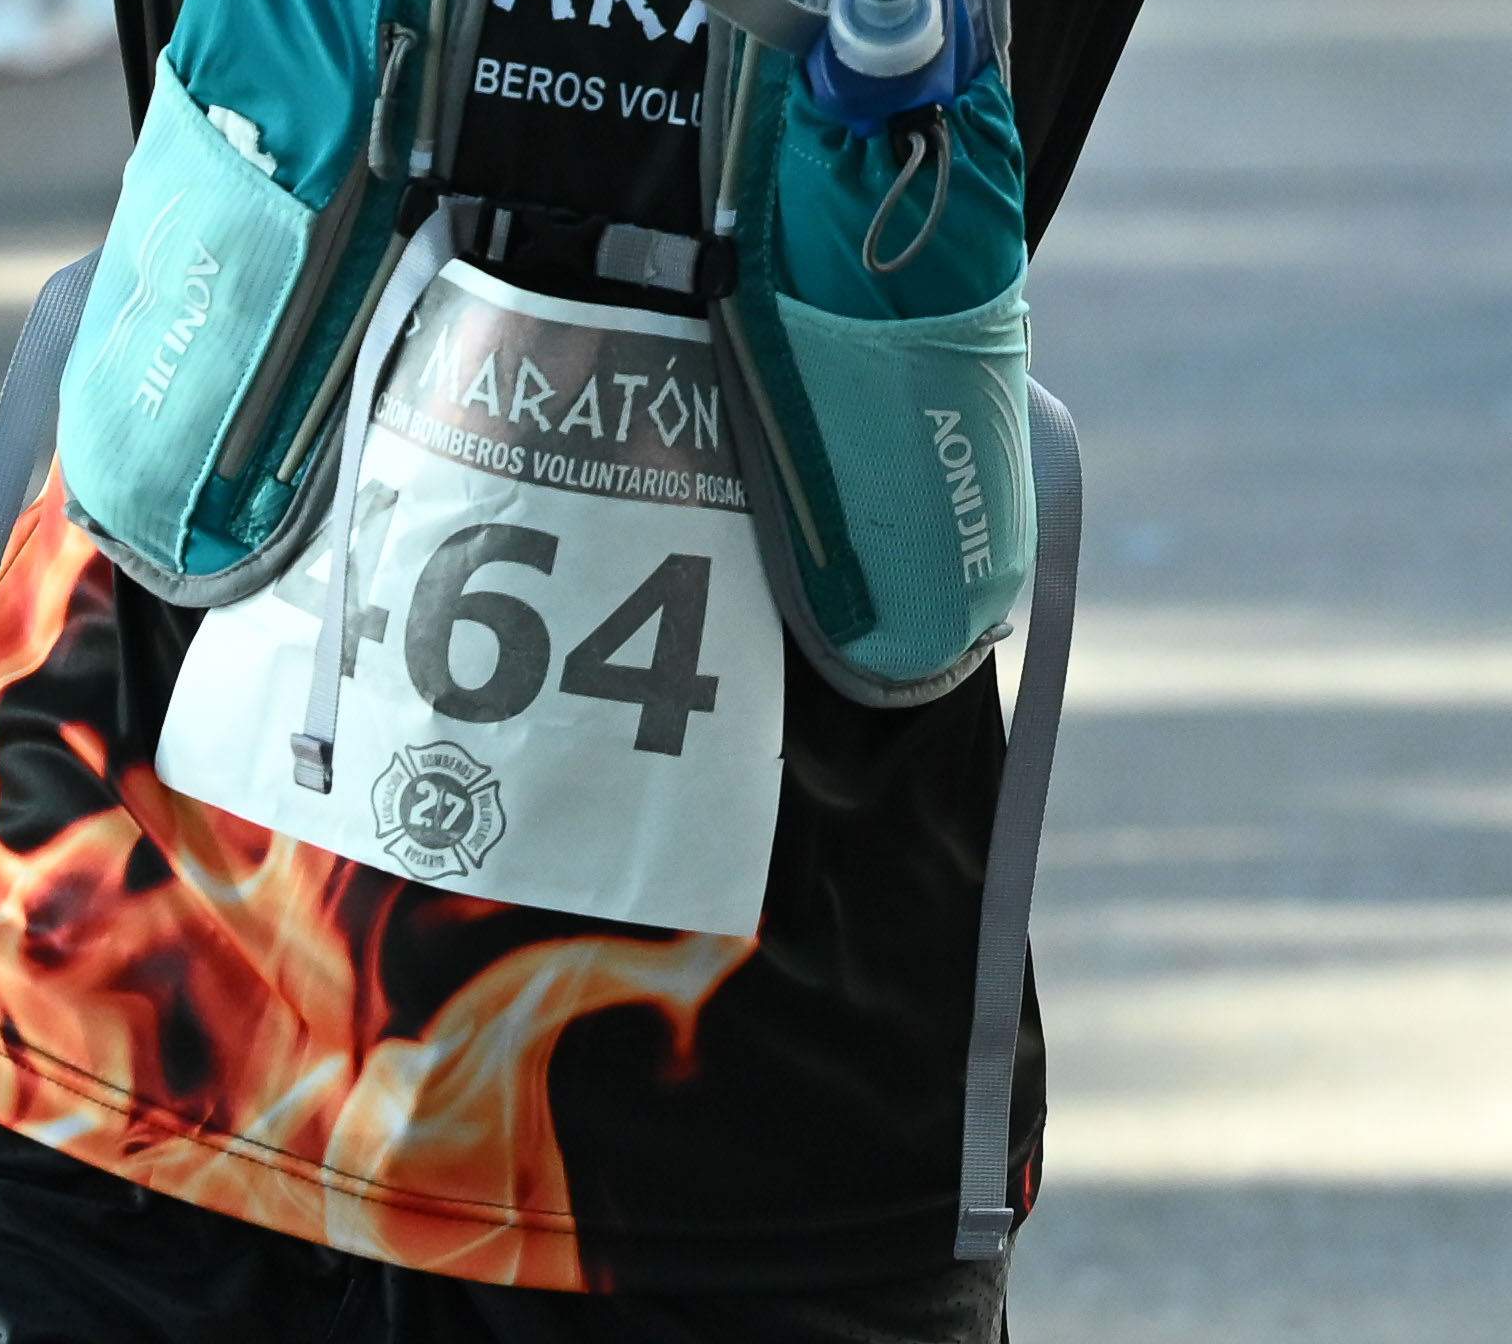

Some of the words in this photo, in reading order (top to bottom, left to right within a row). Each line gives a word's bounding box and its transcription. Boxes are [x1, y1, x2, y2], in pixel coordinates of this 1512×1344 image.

[131, 239, 221, 422] AONIJIE
[418, 323, 719, 452] MARATÓN
[409, 409, 527, 475] BOMBEROS
[533, 451, 690, 500] VOLUNTARIOS
[924, 408, 993, 584] AONIJIE
